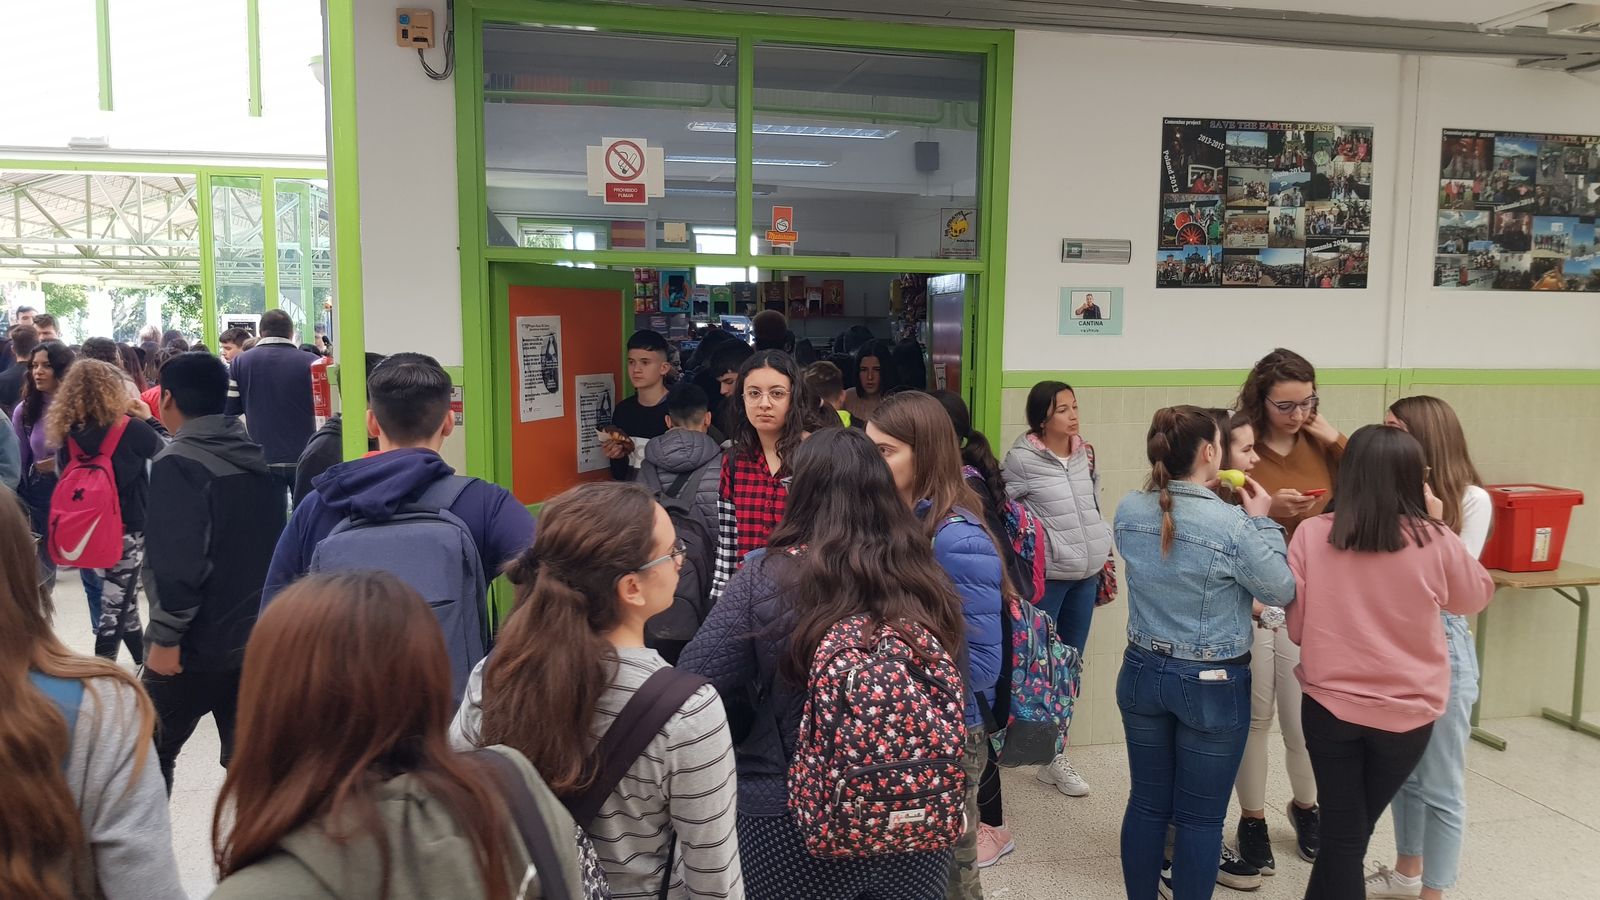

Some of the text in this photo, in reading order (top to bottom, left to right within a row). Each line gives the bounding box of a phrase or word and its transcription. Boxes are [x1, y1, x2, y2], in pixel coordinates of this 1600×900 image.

[1209, 120, 1236, 129] SAVE
[1237, 121, 1258, 130] THE
[1297, 123, 1333, 132] PLEASE
[1198, 134, 1225, 150] 2013-2015
[1163, 150, 1179, 193] Poland 2013
[1271, 165, 1306, 180] Spain 2014
[1306, 238, 1349, 255] Romania 2014
